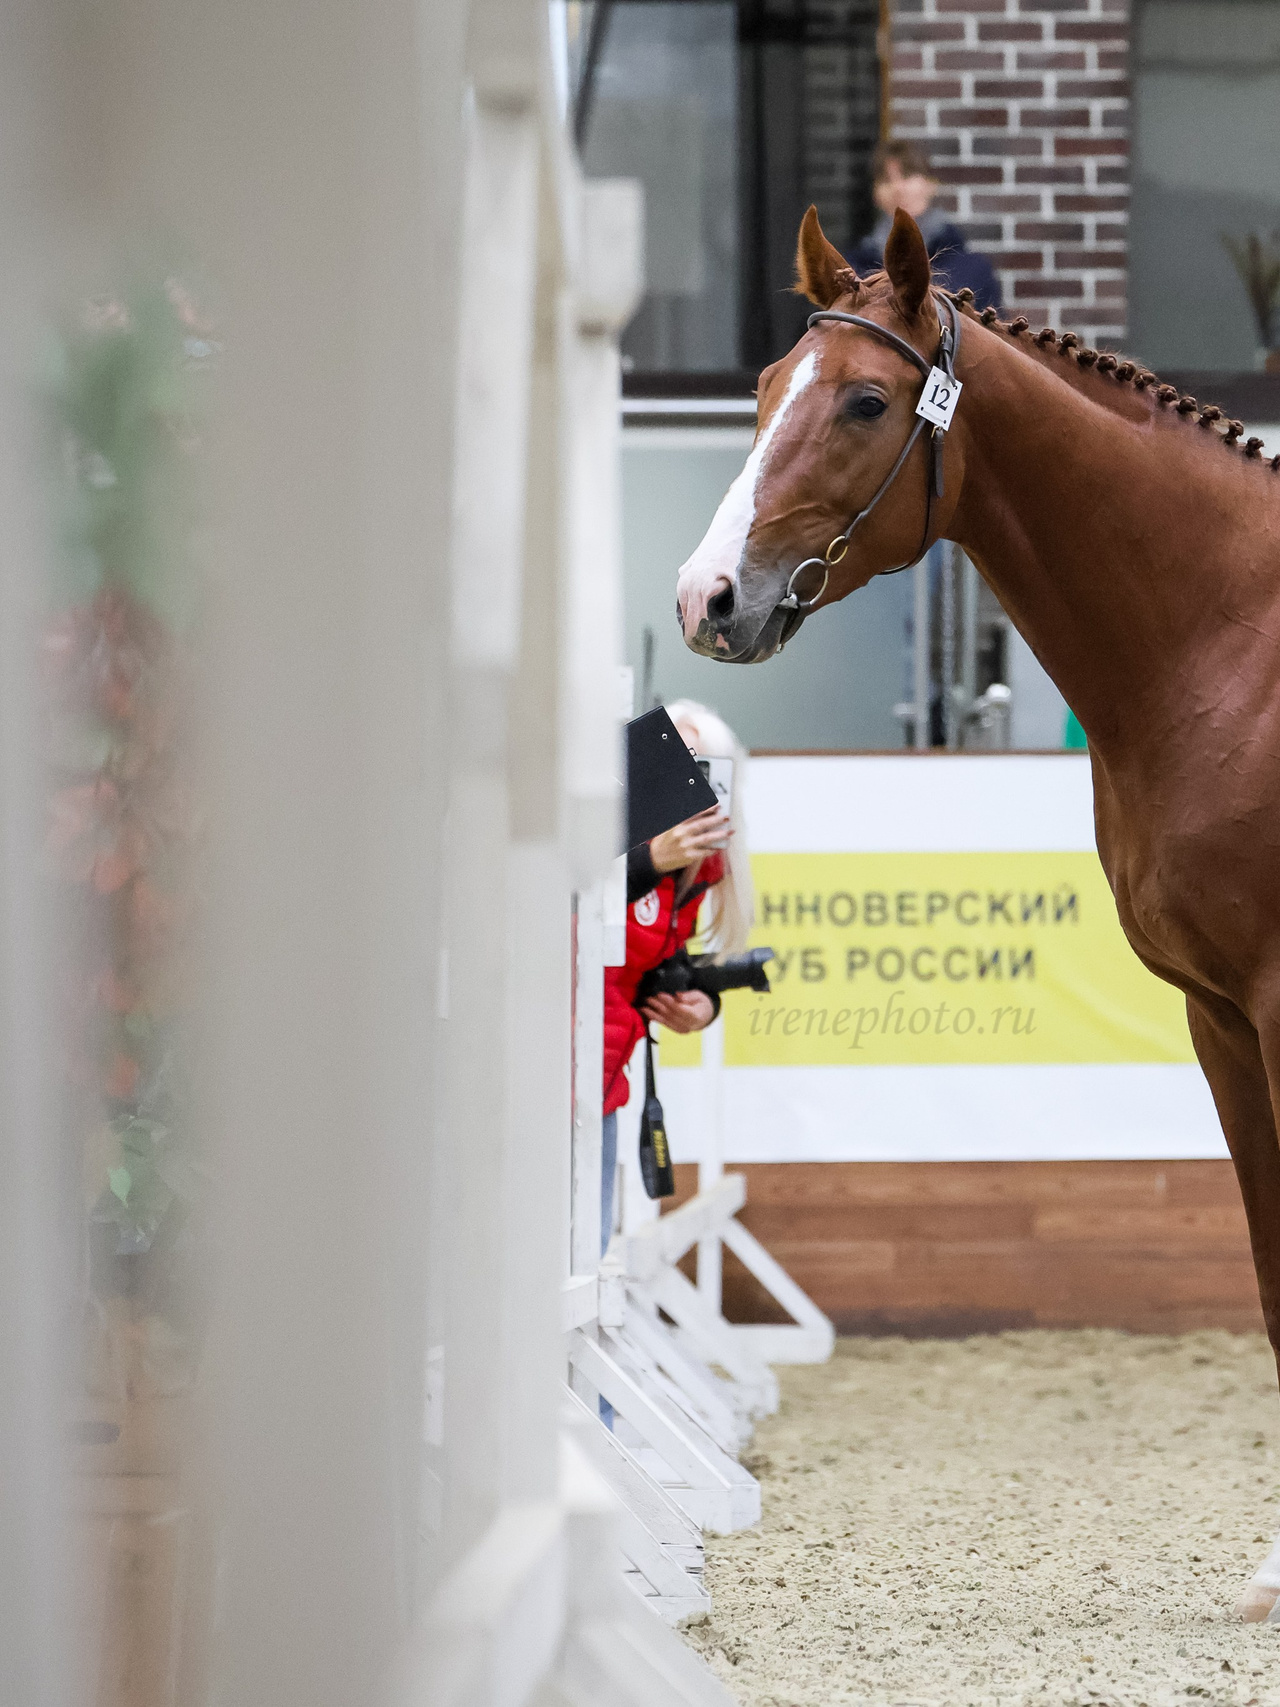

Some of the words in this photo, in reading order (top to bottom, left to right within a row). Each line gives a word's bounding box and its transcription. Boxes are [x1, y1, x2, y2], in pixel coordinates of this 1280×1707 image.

[928, 383, 951, 411] 12
[760, 883, 1080, 927] ННОВЕРСКИЙ
[770, 946, 828, 984] УБ
[846, 946, 1036, 984] РОССИИ
